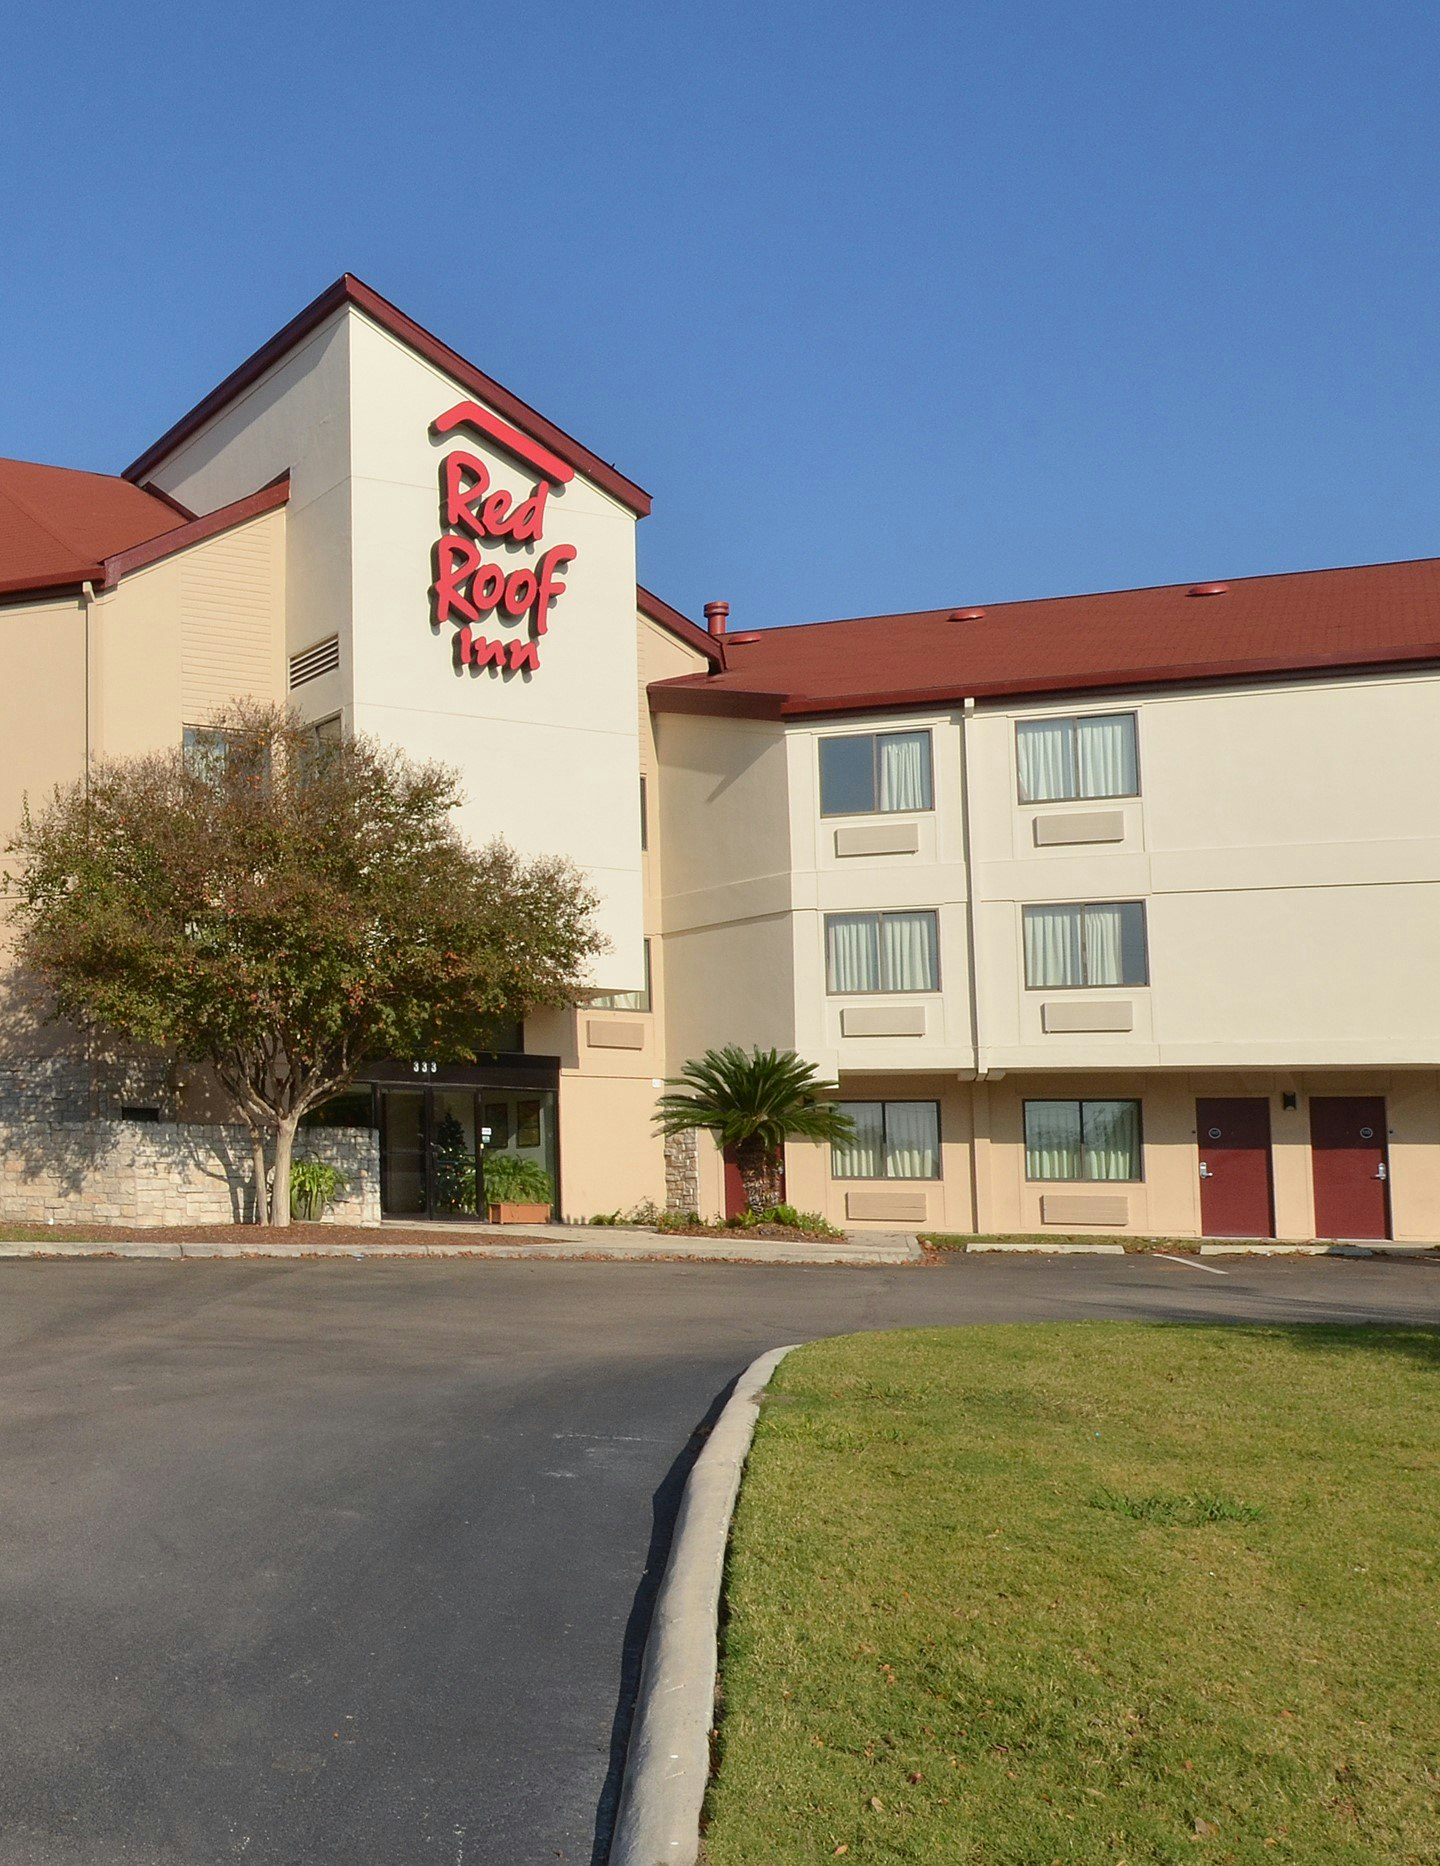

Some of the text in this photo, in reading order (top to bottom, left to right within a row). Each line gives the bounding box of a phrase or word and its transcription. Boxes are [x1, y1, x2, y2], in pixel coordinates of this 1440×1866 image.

[445, 450, 549, 540] Red
[433, 534, 577, 635] Roof
[459, 626, 540, 671] Inn
[413, 1061, 437, 1073] 333
